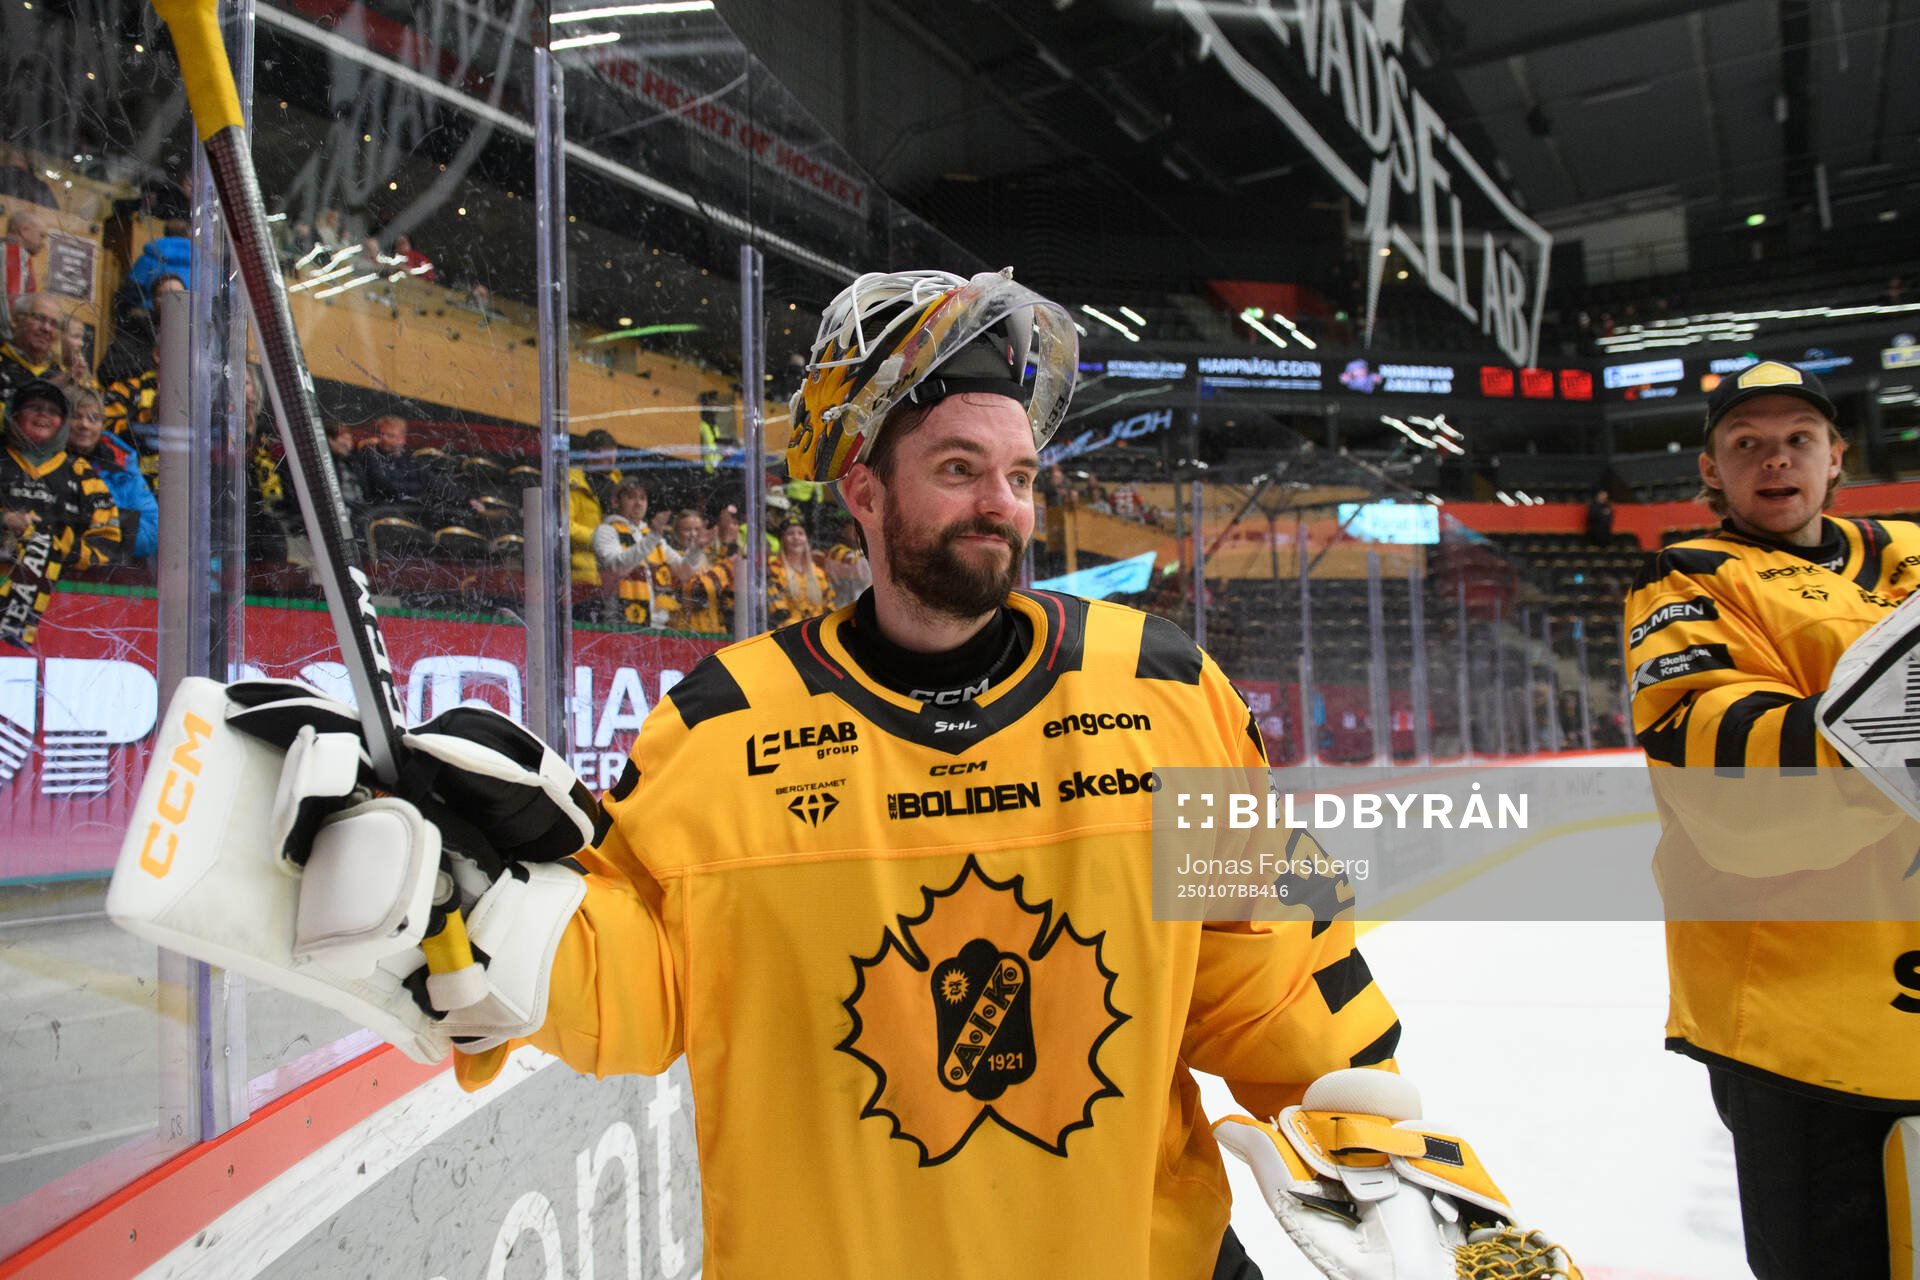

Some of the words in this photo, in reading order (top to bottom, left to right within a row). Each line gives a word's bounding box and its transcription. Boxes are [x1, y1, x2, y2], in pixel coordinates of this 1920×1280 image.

[738, 123, 774, 156] OF
[775, 144, 866, 209] HOCKEY
[1629, 603, 1705, 644] OLMEN
[348, 565, 407, 731] CCM
[1660, 662, 1691, 677] Kraft
[909, 678, 990, 706] CCM
[783, 721, 858, 750] LEAB
[934, 720, 978, 734] SHL
[1043, 712, 1152, 739] engcon
[816, 744, 859, 760] group
[929, 760, 988, 777] CCM
[139, 711, 214, 880] CCM
[775, 778, 847, 795] BERGTEAMET
[1058, 768, 1162, 803] skebo
[897, 781, 1041, 820] BOLIDEN
[988, 1052, 1023, 1071] 1921
